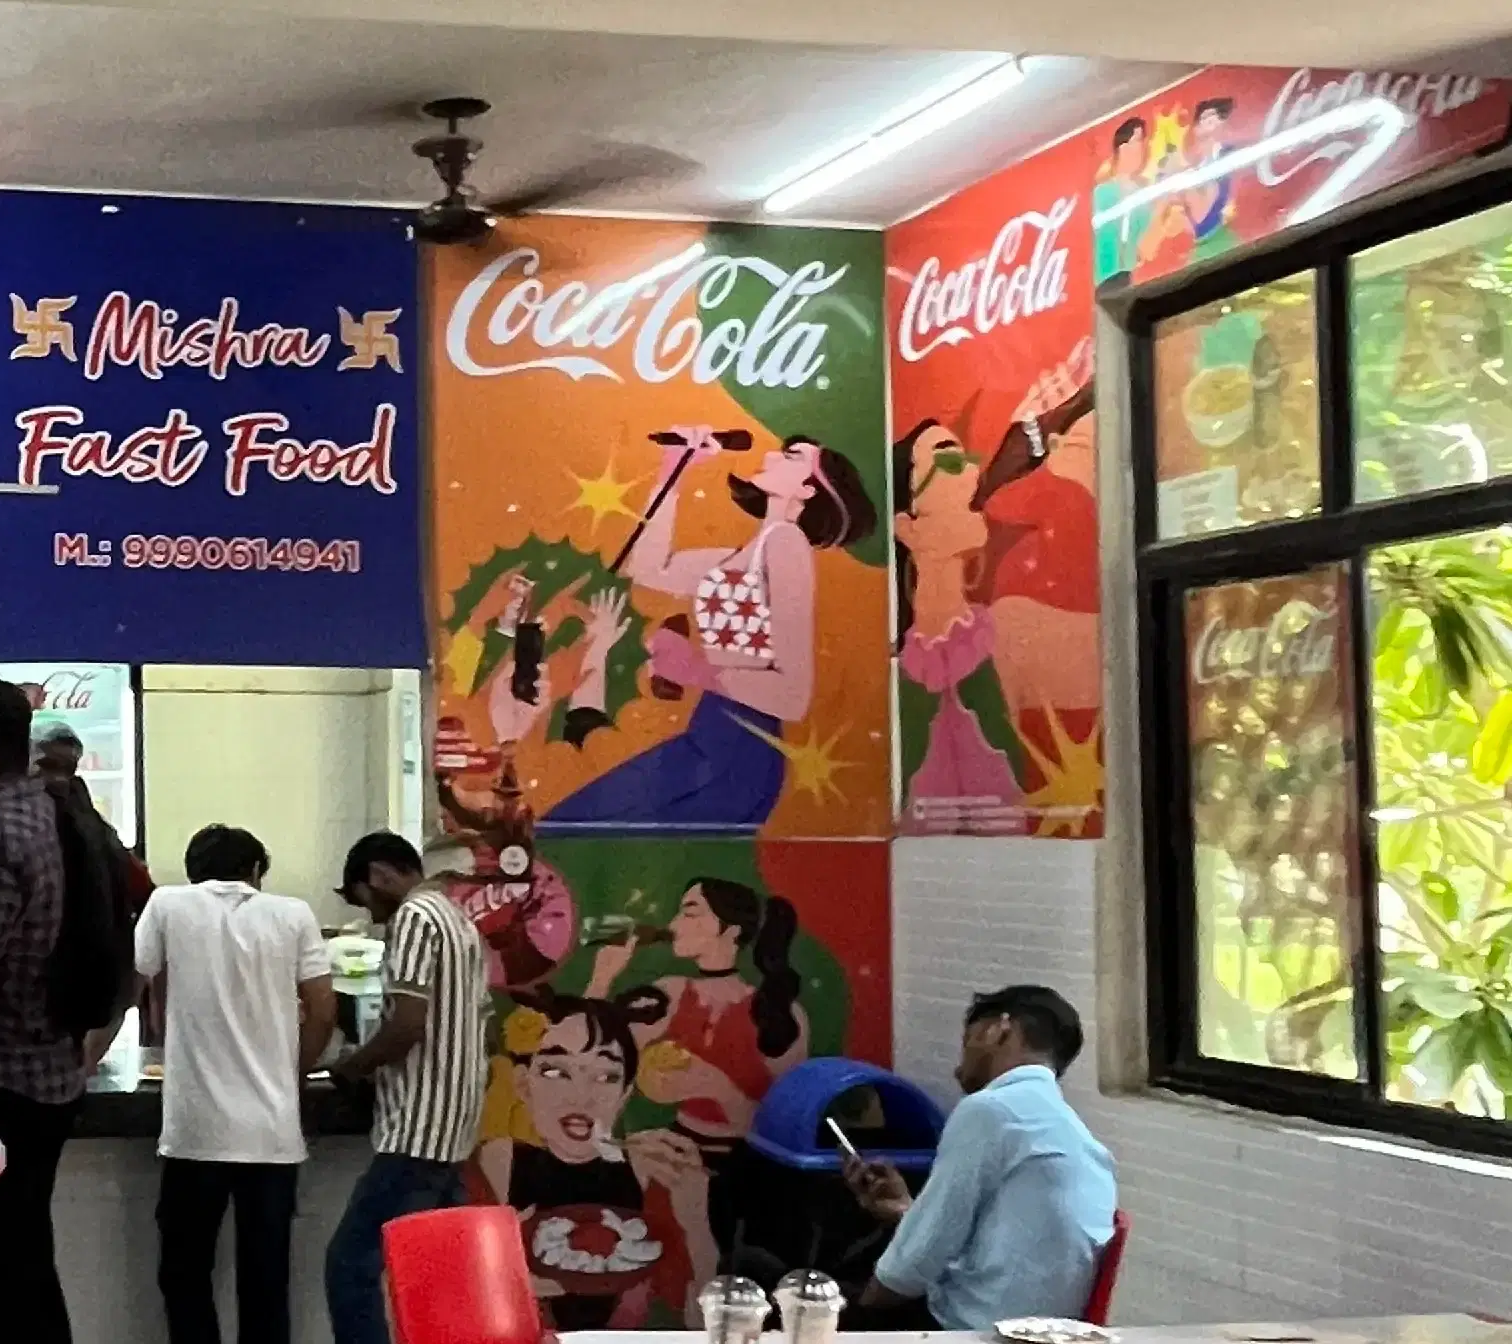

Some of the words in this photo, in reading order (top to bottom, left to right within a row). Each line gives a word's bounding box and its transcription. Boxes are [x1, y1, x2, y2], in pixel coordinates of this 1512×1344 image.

[447, 248, 850, 389] Coca-Cola
[899, 193, 1077, 362] Coca-Cola
[84, 291, 331, 380] Mishra
[16, 405, 209, 488] Fast
[223, 403, 398, 496] Food
[121, 534, 361, 573] 9990614941
